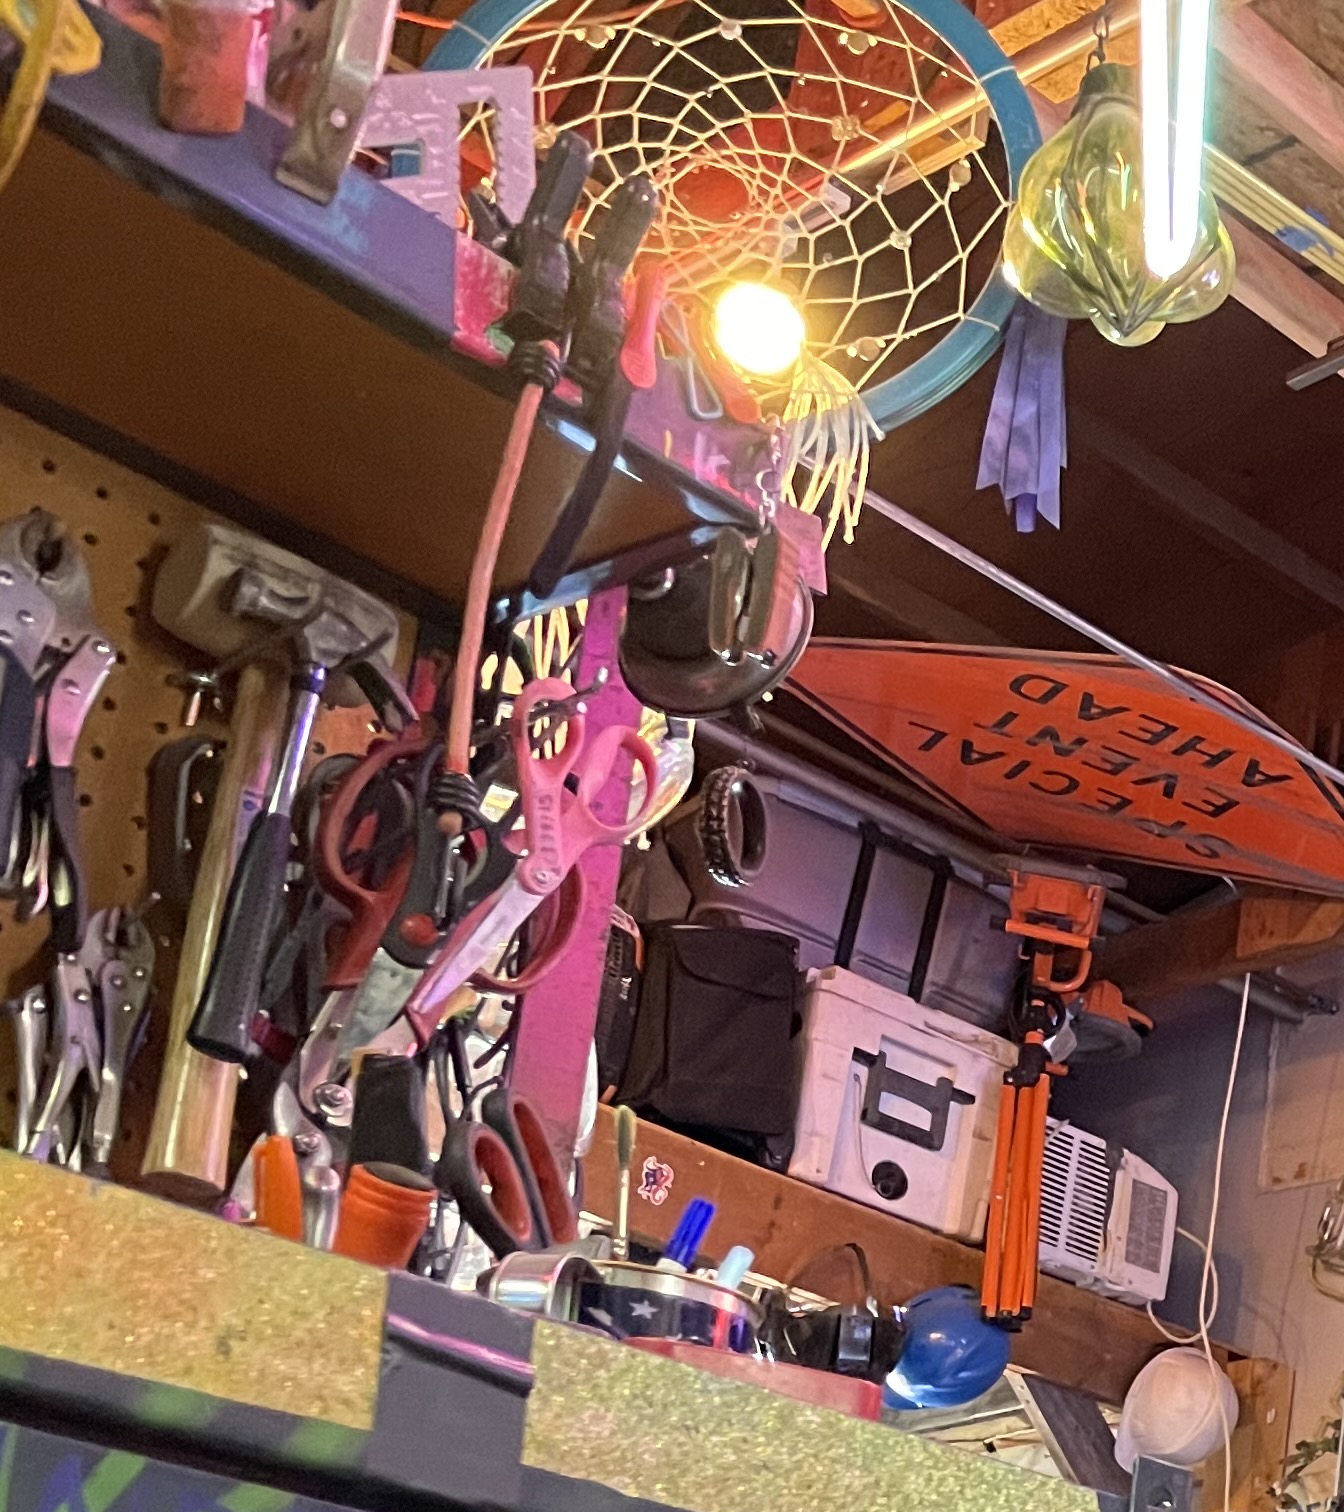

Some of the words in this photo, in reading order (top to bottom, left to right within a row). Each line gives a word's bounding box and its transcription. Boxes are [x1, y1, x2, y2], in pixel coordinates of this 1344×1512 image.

[975, 709, 1240, 818] EVENT
[1007, 671, 1296, 789] AHEAD
[908, 719, 1233, 861] SPECIAL
